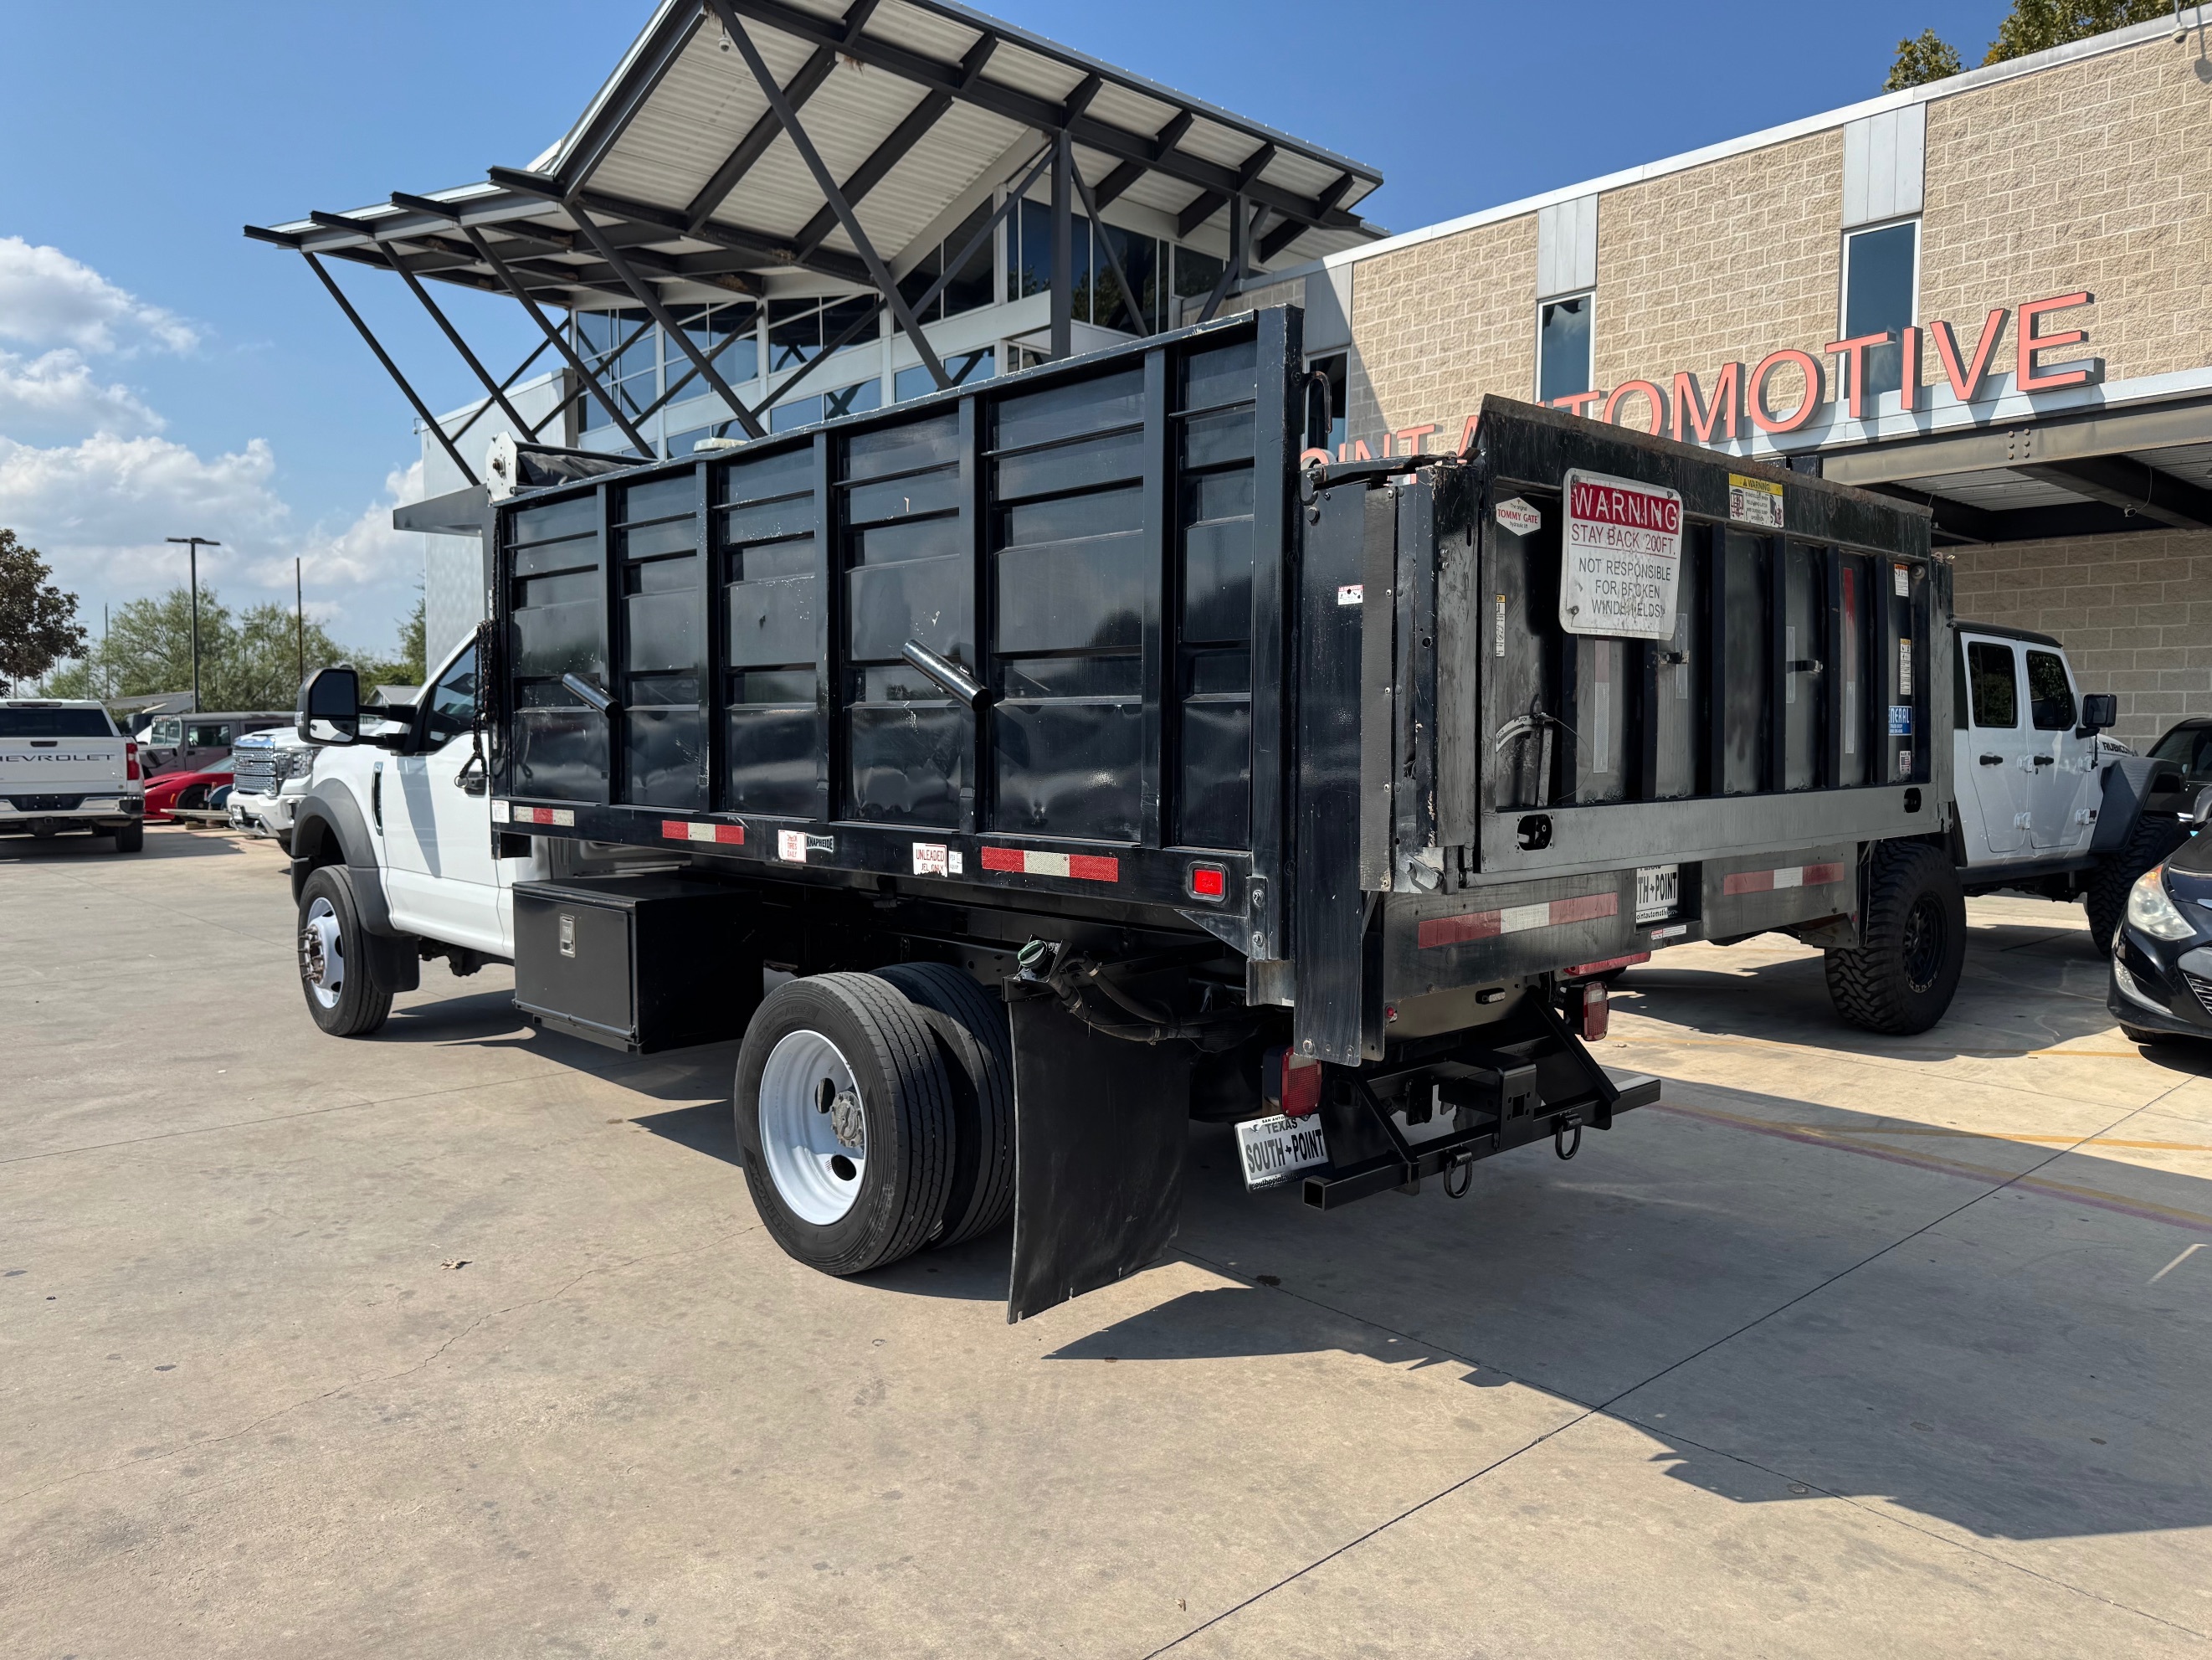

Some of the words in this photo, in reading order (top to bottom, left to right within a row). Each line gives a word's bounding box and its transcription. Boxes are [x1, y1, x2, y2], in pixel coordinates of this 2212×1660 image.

[1748, 479, 1770, 491] WARNING
[1497, 508, 1521, 521] TOMMY
[1523, 513, 1538, 524] GATE
[1574, 487, 1677, 531] WARNING
[1572, 523, 1604, 543] STAY
[1608, 528, 1640, 548] BACK
[1644, 533, 1676, 555] 200FT.
[1579, 558, 1602, 573] NOT
[1606, 560, 1671, 581] RESPONSIBLE
[1595, 579, 1617, 595] FOR
[807, 835, 833, 850] KNAPHEIDE
[916, 849, 945, 861] UNLEADED
[1655, 872, 1676, 902] POINT
[1265, 1118, 1298, 1134] TEXAS
[1245, 1138, 1286, 1174] SOUTH
[1291, 1128, 1324, 1162] POINT
